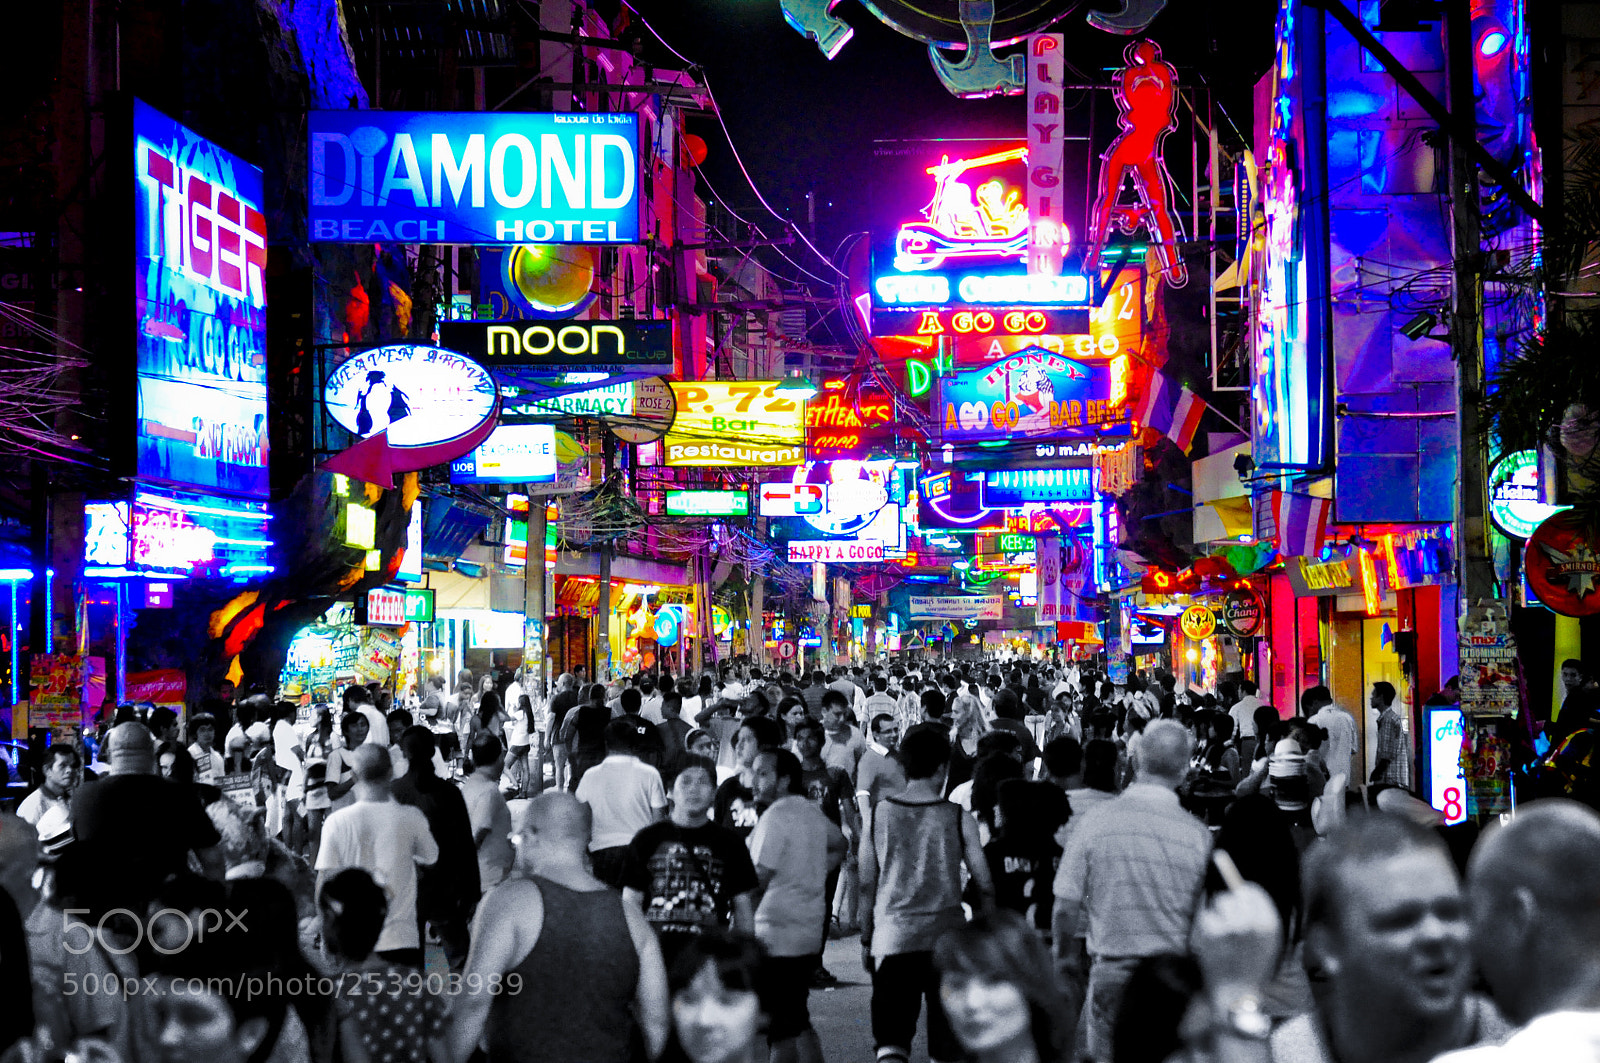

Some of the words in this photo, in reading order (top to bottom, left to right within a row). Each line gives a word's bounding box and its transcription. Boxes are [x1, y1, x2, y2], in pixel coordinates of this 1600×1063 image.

[138, 148, 268, 308] TIGER
[314, 219, 446, 241] BEACH
[495, 220, 633, 242] HOTEL
[917, 311, 944, 334] A
[984, 339, 1006, 358] A
[983, 351, 1085, 386] HONEY
[639, 396, 662, 410] ROSE
[665, 399, 671, 410] 2
[711, 416, 758, 431] Bar
[944, 402, 960, 430] A
[1050, 400, 1083, 426] BAR
[669, 446, 801, 462] Restaurant
[453, 463, 474, 472] UOB
[1031, 489, 1087, 498] FASHION
[790, 546, 830, 560] HAPPY
[836, 548, 844, 558] A
[368, 593, 404, 621] TATTOO
[1227, 607, 1258, 621] Chang
[47, 674, 68, 694] 29
[1443, 787, 1462, 820] 8
